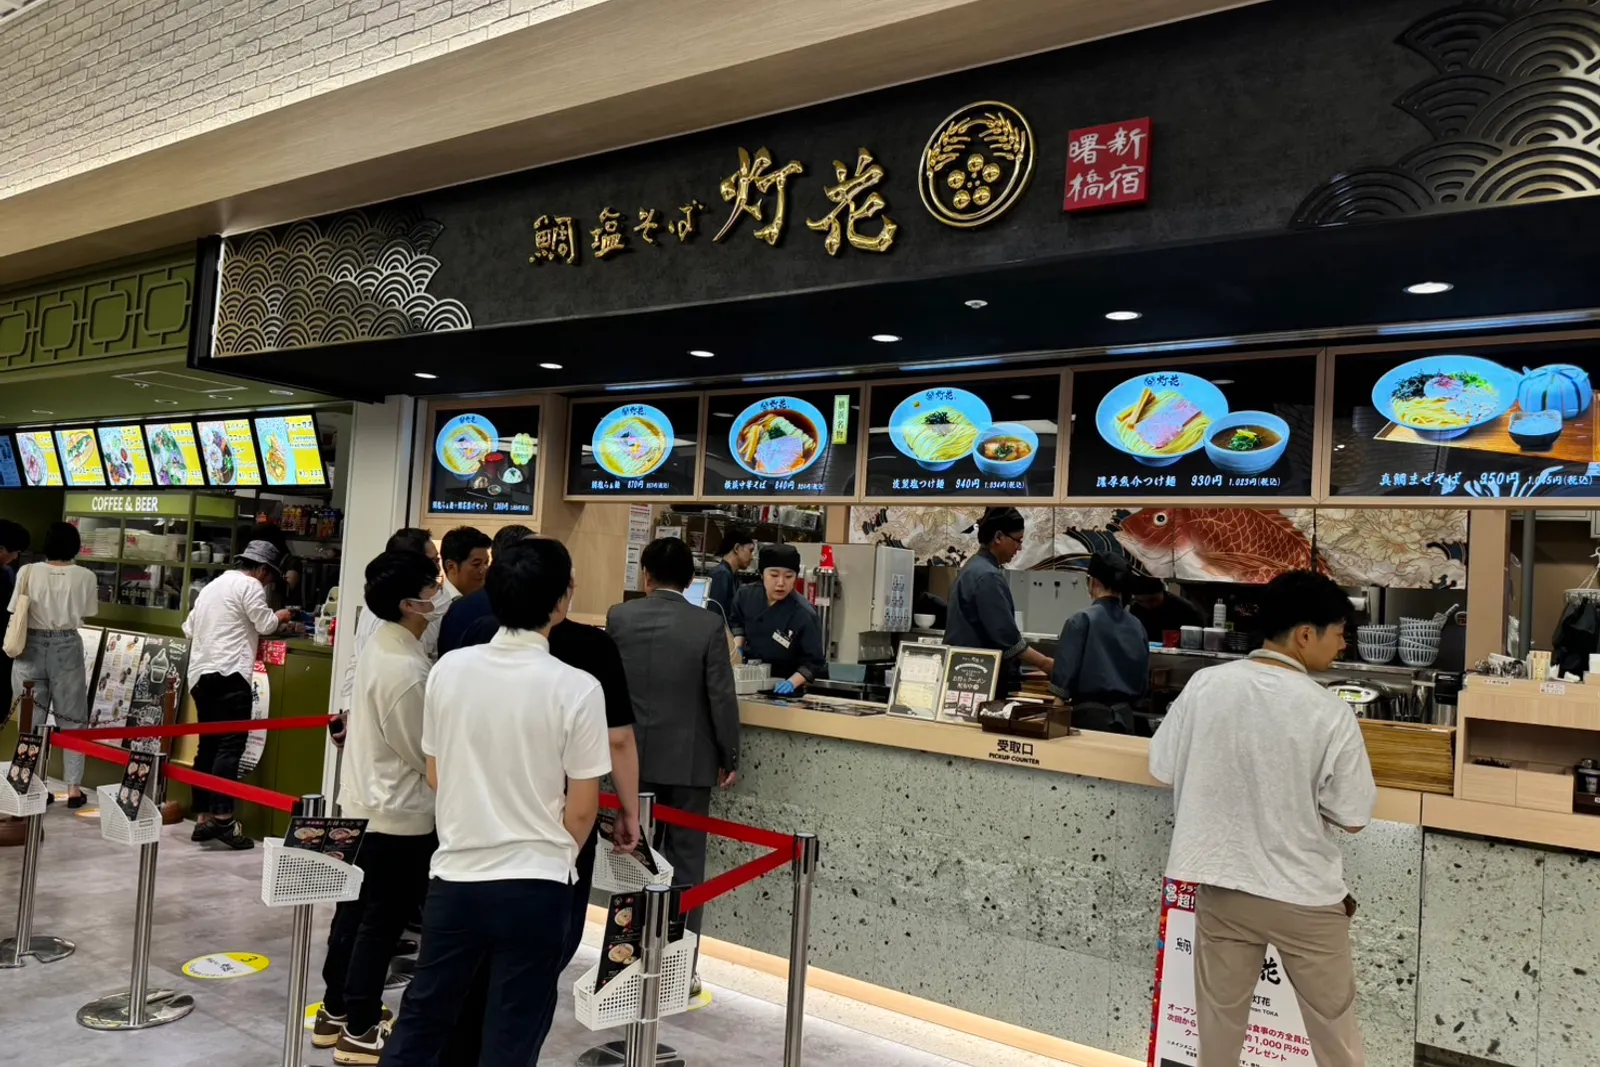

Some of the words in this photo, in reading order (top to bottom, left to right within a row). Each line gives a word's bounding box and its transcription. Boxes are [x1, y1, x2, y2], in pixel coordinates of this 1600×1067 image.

[712, 146, 898, 257] 灯花
[956, 479, 980, 489] 940円
[1096, 475, 1177, 488] 濃厚魚介つけ麺
[1191, 475, 1223, 487] 930円
[1379, 471, 1462, 487] 真鯛まぜそば
[91, 496, 124, 511] COFFEE
[124, 496, 133, 512] &
[135, 496, 159, 512] BEER
[997, 739, 1034, 756] 受取口
[988, 752, 1010, 760] PICKUP
[1011, 755, 1040, 765] COUNTER
[1260, 957, 1281, 985] 花
[1167, 1013, 1197, 1028] 次回から
[1263, 1009, 1279, 1017] TOKA
